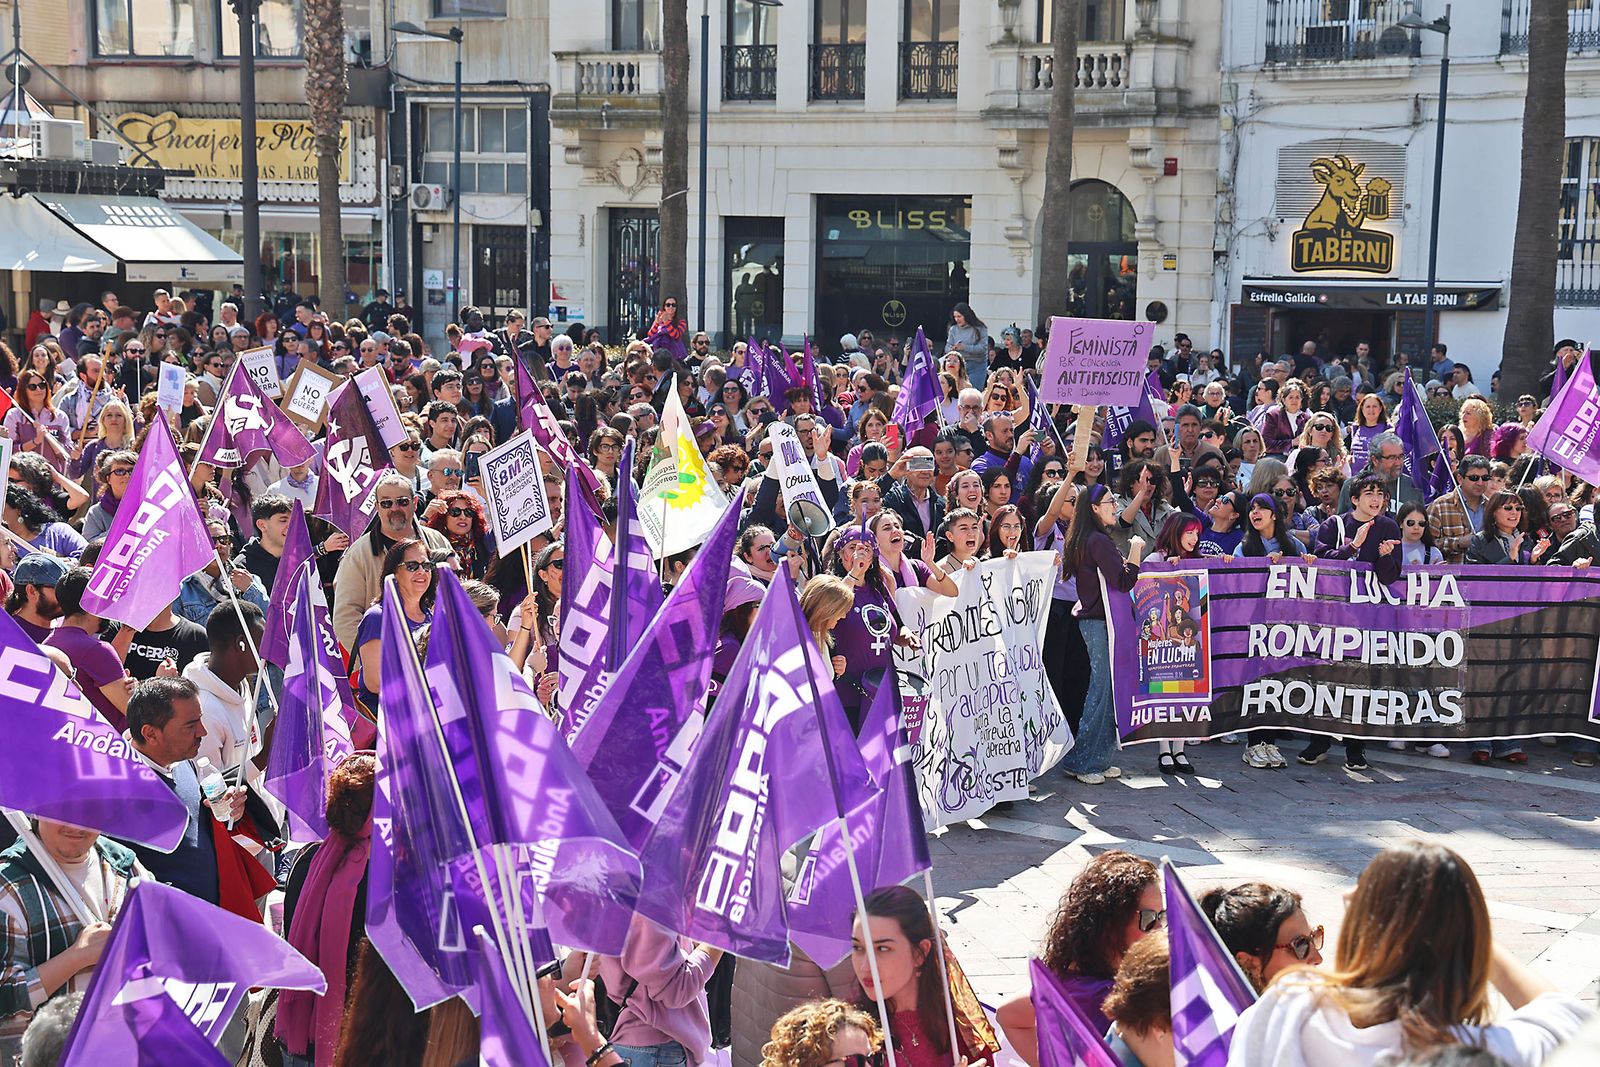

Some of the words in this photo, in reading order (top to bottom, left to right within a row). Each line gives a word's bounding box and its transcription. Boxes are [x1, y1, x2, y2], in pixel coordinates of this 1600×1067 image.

[117, 117, 266, 166] Encajera
[848, 210, 946, 230] BLISS
[1250, 292, 1283, 302] Estrella
[1284, 292, 1316, 303] Galicia
[1386, 293, 1402, 305] LA
[249, 366, 269, 378] NO
[303, 385, 320, 399] NO
[307, 397, 316, 406] LA
[292, 398, 319, 415] GUERRA
[499, 459, 522, 487] 8M
[504, 467, 534, 494] FEMINISMO
[505, 477, 533, 501] FASCISMO
[1266, 564, 1318, 600] EN
[1248, 623, 1465, 668] ROMPIENDO
[1147, 649, 1159, 666] EN
[1161, 647, 1196, 666] LUCHA
[1240, 679, 1463, 726] FRONTERAS
[997, 706, 1013, 724] la
[1130, 705, 1212, 727] HUELVA
